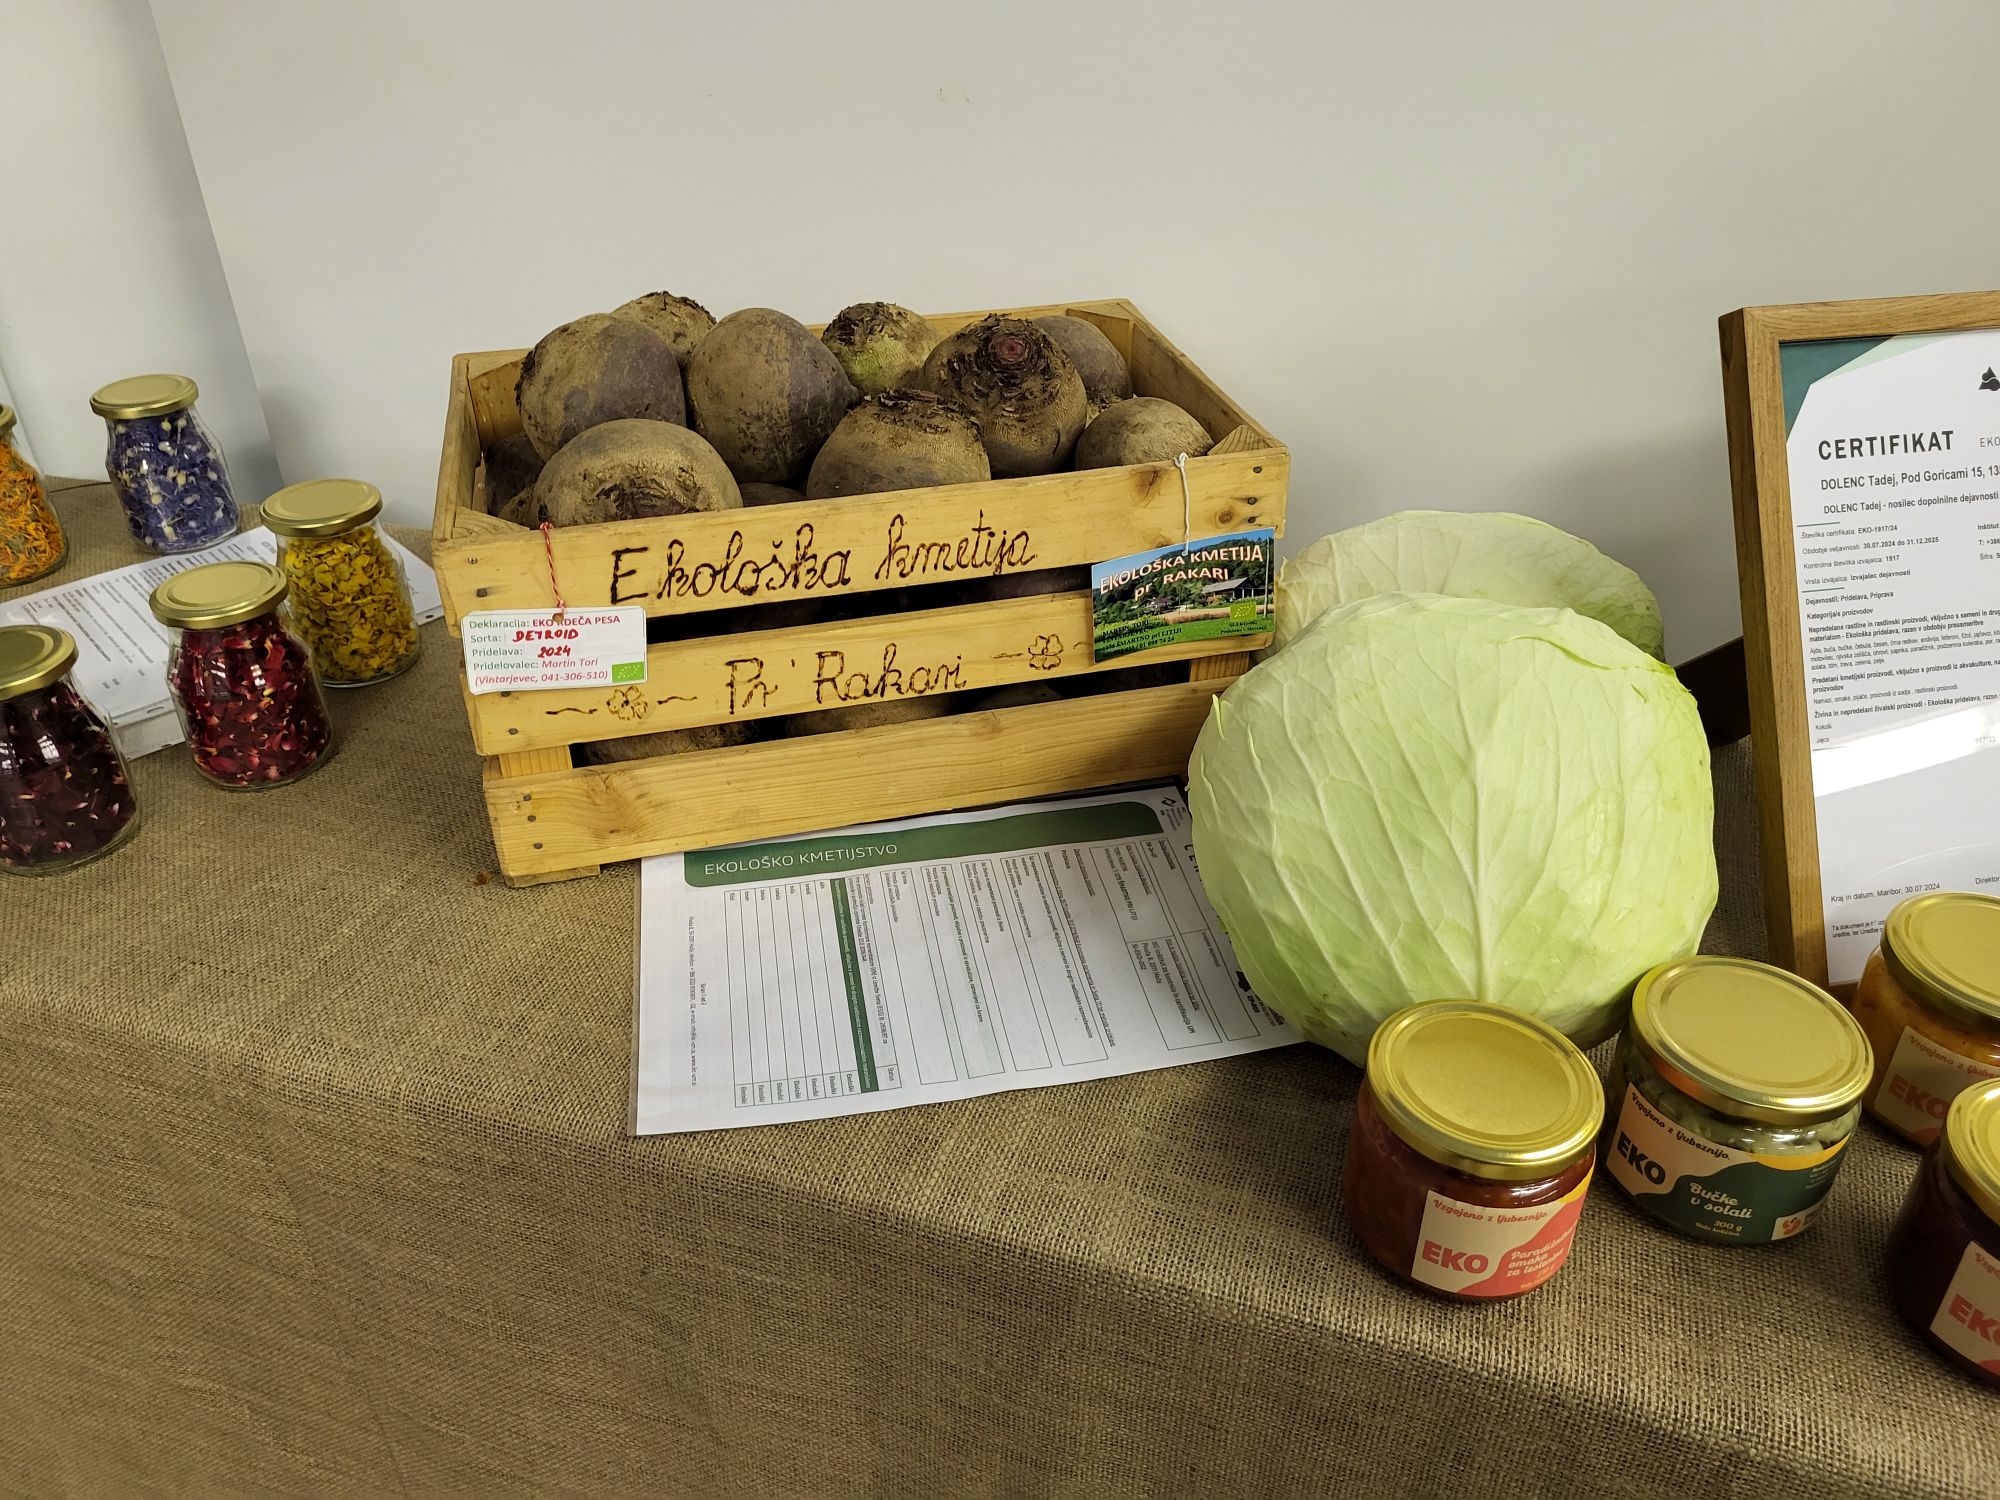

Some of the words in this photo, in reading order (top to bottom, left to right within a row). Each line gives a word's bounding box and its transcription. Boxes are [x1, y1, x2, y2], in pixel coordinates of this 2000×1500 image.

[1818, 431, 1953, 460] CERTIFIKAT
[1821, 476, 1865, 490] DOLENC
[1868, 476, 1899, 487] Tadej,
[1901, 472, 1921, 483] Pod
[1923, 467, 1968, 482] Goricami
[1971, 467, 1985, 478] 15,
[1824, 503, 1858, 514] DOLENC
[1860, 501, 1882, 511] Tadej
[1888, 499, 1915, 509] nosilec
[1918, 495, 1957, 508] dopolnilne
[1960, 492, 1999, 504] dejavnosti
[1858, 525, 1898, 534] EKO-1917/24
[1863, 540, 1896, 549] 30.07.2024
[1907, 537, 1939, 545] 31.12.2025
[610, 523, 852, 605] Ekološka
[875, 509, 1038, 580] kmetija
[1100, 555, 1185, 595] EKOLOŠKA
[1190, 544, 1263, 563] KMETIJA
[1163, 567, 1228, 585] RAKARI
[1850, 572, 1877, 582] Izvajalec
[1879, 569, 1911, 580] dejavnosti
[1841, 593, 1869, 602] Pridelava,
[1870, 591, 1893, 600] Priprava
[1808, 624, 1844, 633] Nepredelane
[1845, 621, 1866, 630] rastline
[1875, 618, 1900, 626] rastlinski
[1931, 612, 1954, 622] vključno
[1960, 610, 1981, 618] semeni
[1842, 608, 1873, 618] proizvodov
[469, 620, 529, 630] Deklaracija:
[532, 619, 553, 627] EKO
[595, 616, 620, 625] PESA
[1846, 630, 1871, 639] Ekološka
[1923, 622, 1946, 632] obdobju
[1948, 620, 1984, 630] preusmeritve
[471, 635, 501, 643] Sorta:
[512, 629, 579, 642] DETROID
[472, 648, 523, 657] Pridelava:
[537, 645, 571, 658] 2024
[474, 662, 539, 671] Pridelovalec:
[542, 659, 575, 668] Martin
[580, 658, 598, 667] Tori
[813, 643, 966, 704] Rakari
[475, 676, 538, 687] (Vintarjevec,
[542, 671, 608, 681] 041-306-510)
[1812, 675, 1839, 684] Predelani
[1840, 672, 1866, 682] kmetijski
[1896, 666, 1920, 676] vključno
[1926, 664, 1952, 674] proizvodi
[1813, 685, 1844, 694] proizvodov
[1814, 709, 1832, 718] Živina
[1840, 707, 1873, 717] nepredelani
[1897, 701, 1923, 711] proizvodi
[1928, 697, 1953, 706] Ekološka
[704, 854, 794, 876] EKOLOŠKO
[799, 844, 897, 866] KMETIJSTVO
[1975, 876, 2000, 885] Direktor
[1831, 895, 1844, 903] Kraj
[1853, 892, 1875, 900] datum:
[1877, 888, 1903, 897] Maribor,
[1888, 1073, 1952, 1119] EKO
[1631, 1092, 1666, 1128] Vzgojeno
[1675, 1129, 1731, 1161] ljubeznijo.
[1617, 1131, 1666, 1185] EKO
[1690, 1183, 1739, 1205] Bučke
[1433, 1199, 1484, 1221] Vzgojeno
[1704, 1203, 1752, 1218] solati
[1714, 1220, 1734, 1229] 300
[1422, 1239, 1489, 1274] EKO
[1509, 1253, 1548, 1268] omaka
